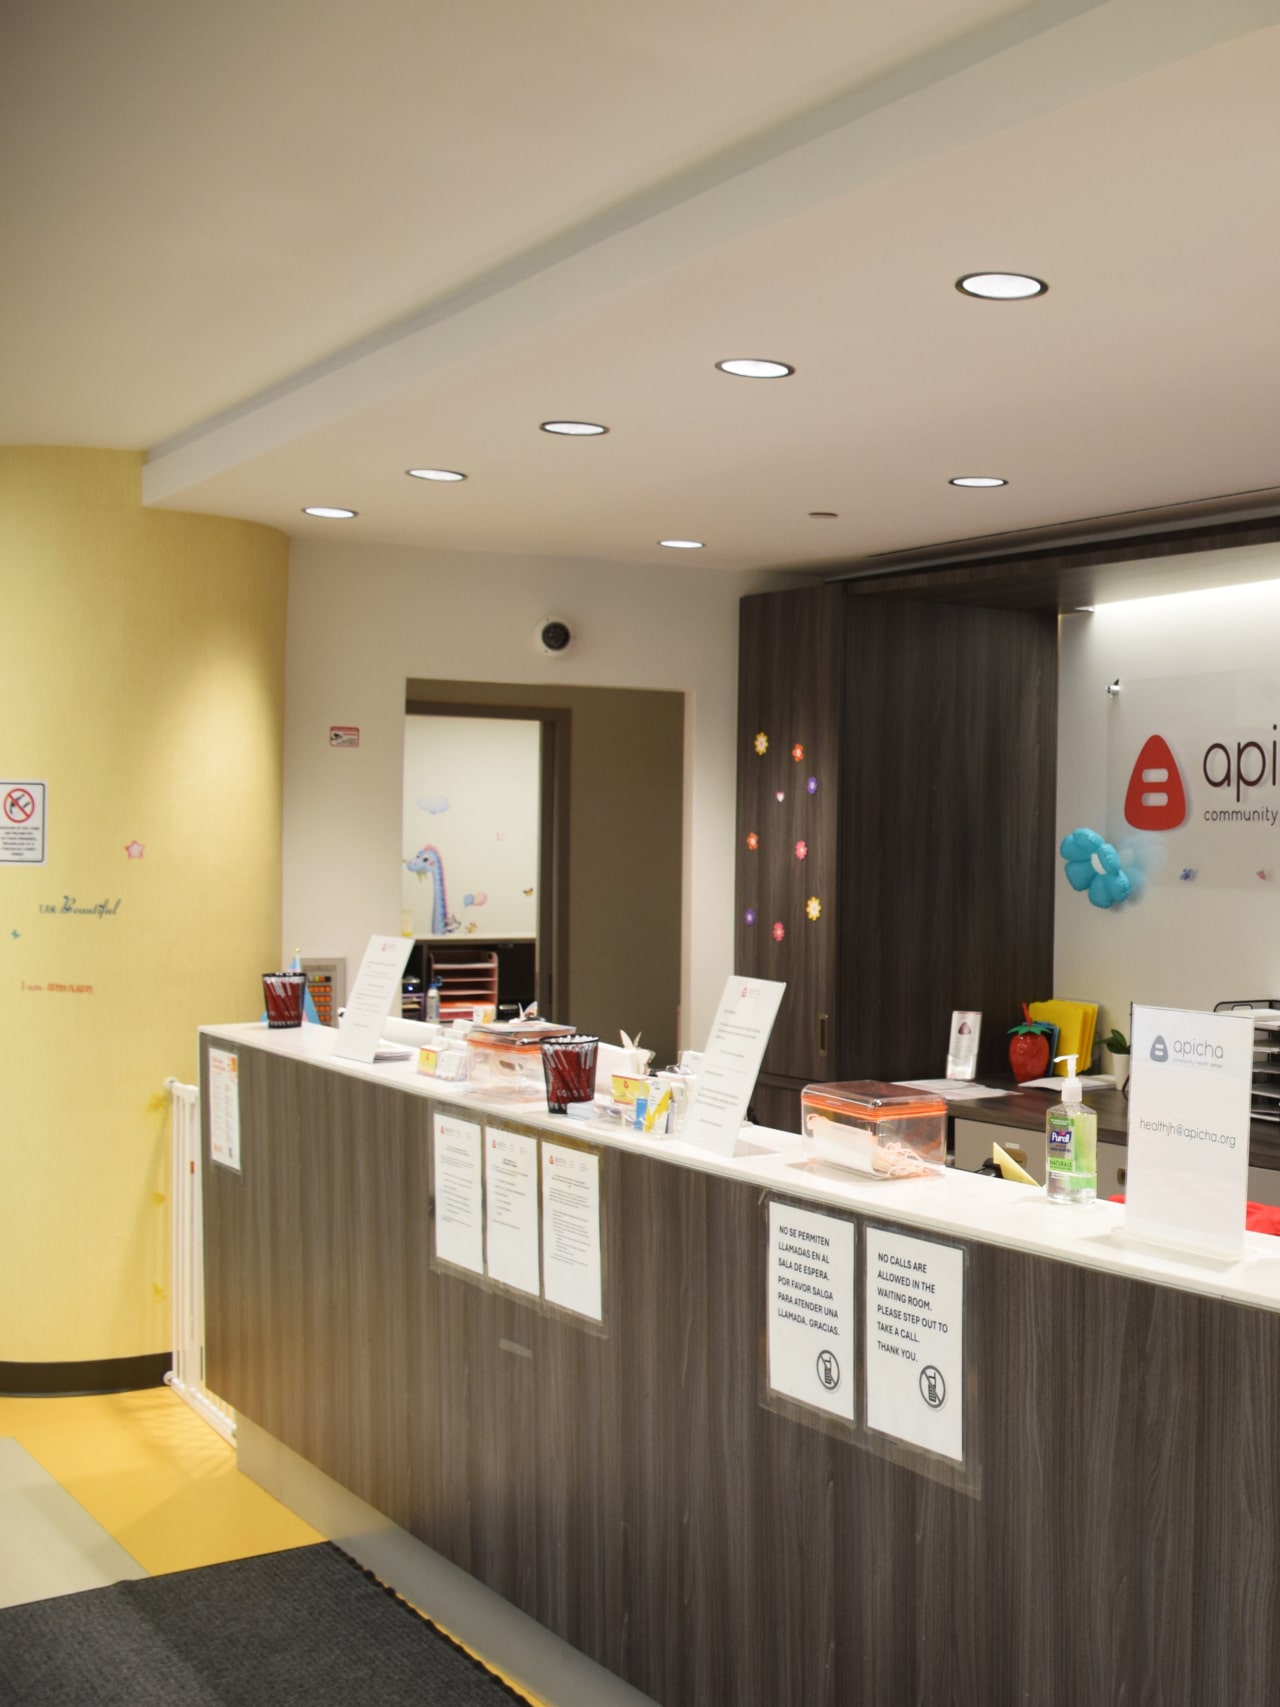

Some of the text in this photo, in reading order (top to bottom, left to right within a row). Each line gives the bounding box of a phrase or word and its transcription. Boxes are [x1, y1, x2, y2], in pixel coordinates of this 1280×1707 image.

[1203, 806, 1279, 826] community
[60, 895, 121, 919] Beautiful
[1173, 1037, 1224, 1059] apicha
[1139, 1119, 1236, 1149] healthjh@apicha.org
[1049, 1160, 1072, 1168] NATURALS
[779, 1225, 830, 1247] NO SE PERMITEN
[778, 1241, 830, 1264] LLAMADAS EN AL
[878, 1252, 927, 1274] NO CALLS ARE
[778, 1257, 830, 1280] SALA DE ESPERA.
[778, 1275, 834, 1301] POR FAVOR SALGA
[877, 1269, 936, 1294] ALLOWED IN THE
[778, 1292, 839, 1319] PARA ATENDER UNA
[877, 1286, 932, 1311] WAITING ROOM.
[778, 1308, 840, 1336] LLAMADA. GRACIAS.
[877, 1304, 948, 1334] PLEASE STEP OUT TO
[877, 1321, 920, 1343] TAKE A CALL.
[877, 1340, 918, 1362] THANK YOU.
